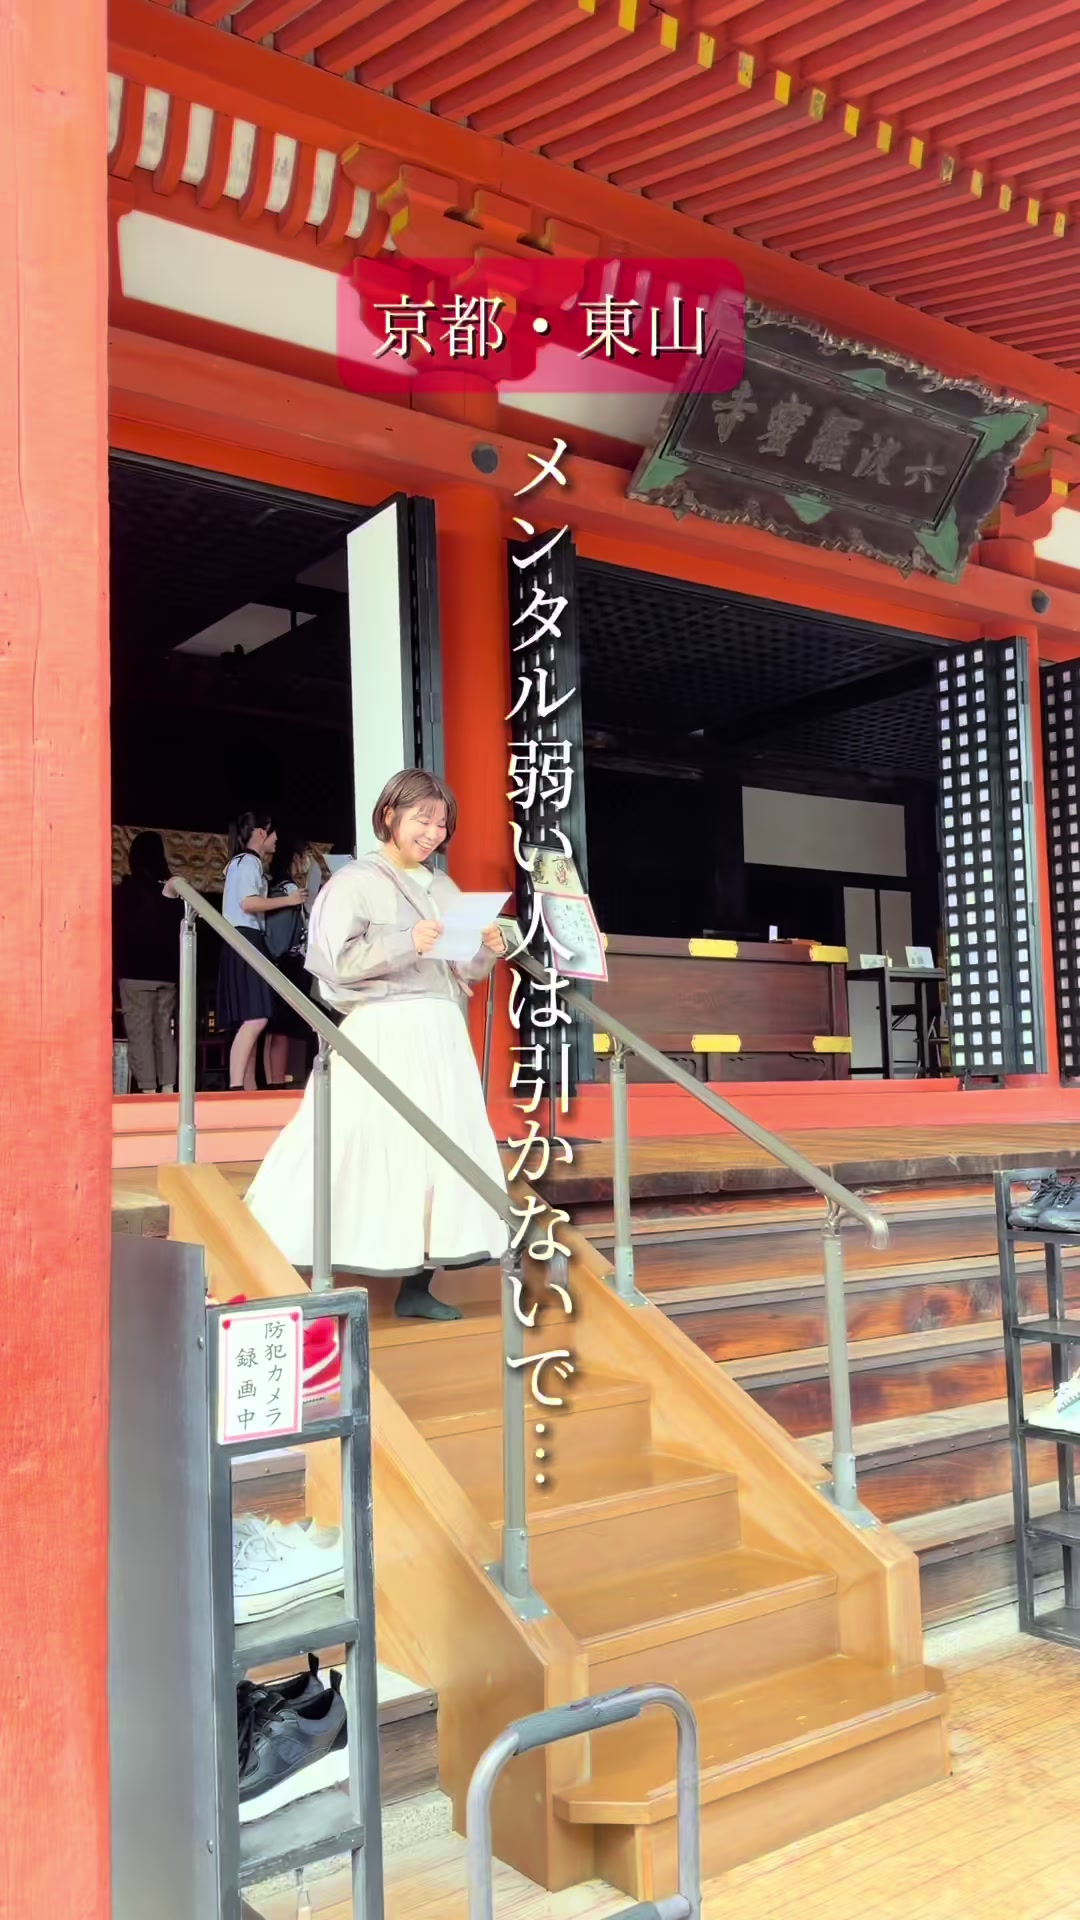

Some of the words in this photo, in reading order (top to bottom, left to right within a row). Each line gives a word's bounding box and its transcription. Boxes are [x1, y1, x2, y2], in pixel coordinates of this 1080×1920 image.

[234, 1347, 259, 1431] 録画中
[264, 1320, 287, 1427] 防犯カメラ
